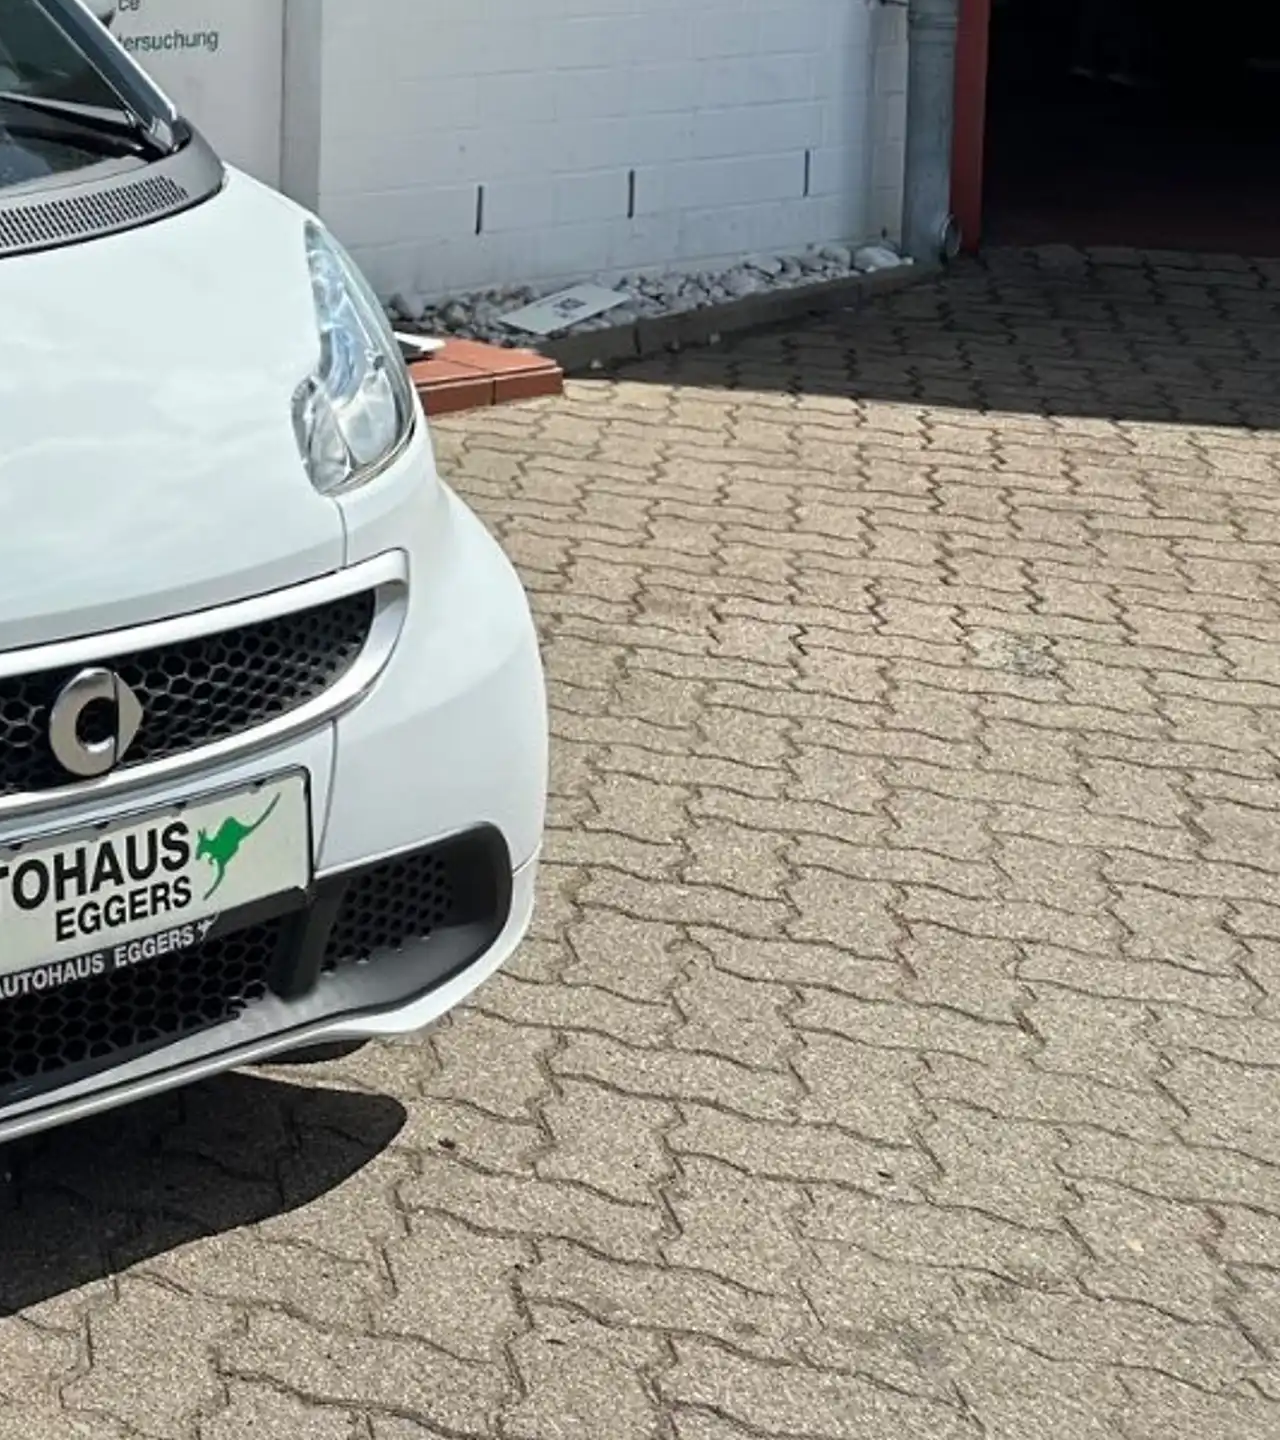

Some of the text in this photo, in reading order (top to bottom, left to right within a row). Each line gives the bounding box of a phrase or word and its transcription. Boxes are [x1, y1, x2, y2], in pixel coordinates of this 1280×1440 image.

[117, 29, 219, 52] tersuchung
[56, 876, 192, 943] EGGERS
[114, 930, 195, 969] EGGERS
